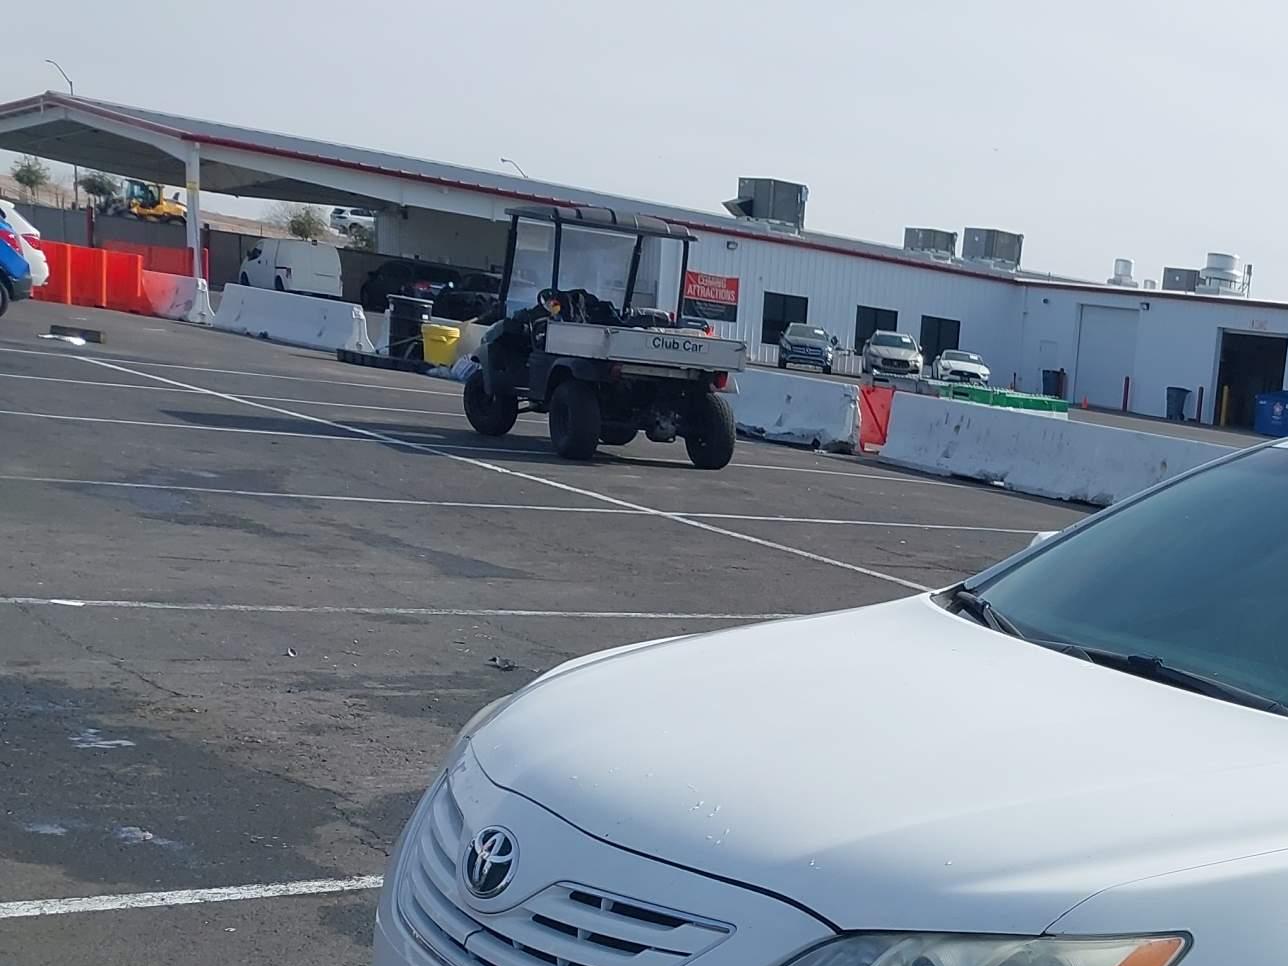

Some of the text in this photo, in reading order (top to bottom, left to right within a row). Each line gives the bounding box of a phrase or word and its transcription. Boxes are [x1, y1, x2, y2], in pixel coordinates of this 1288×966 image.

[687, 284, 736, 302] ATTRACTIONS
[652, 337, 705, 352] Club Car
